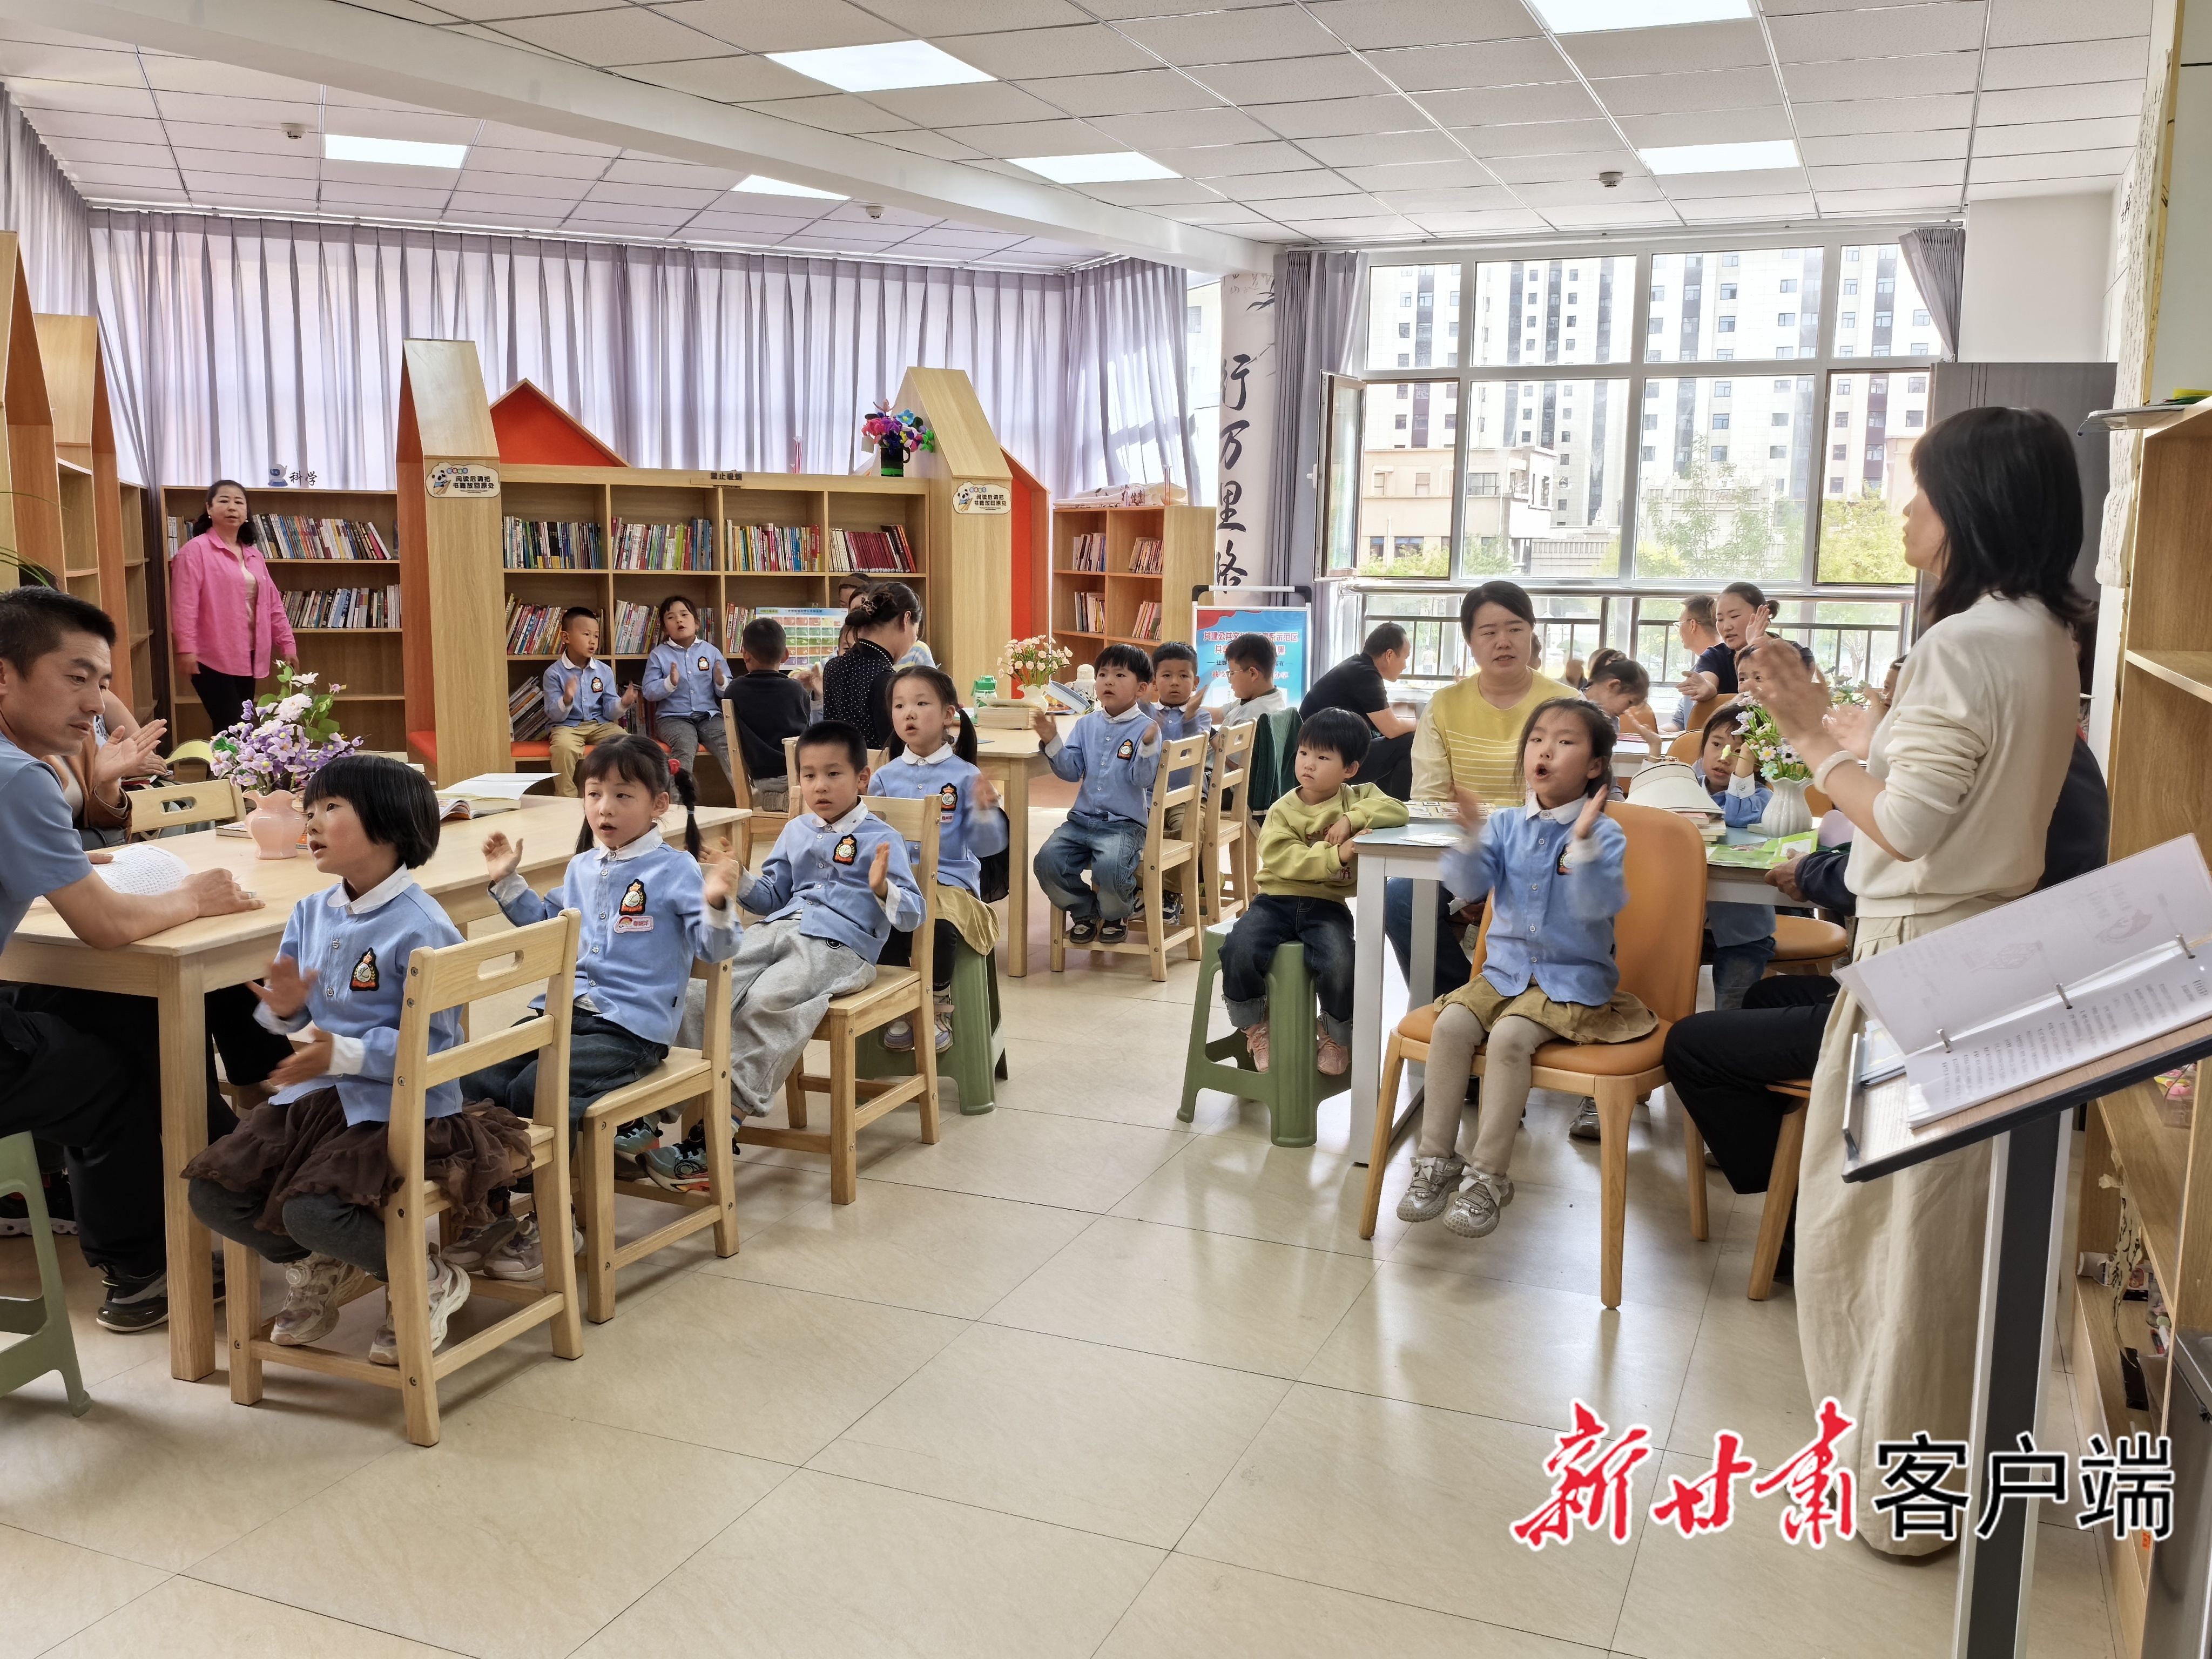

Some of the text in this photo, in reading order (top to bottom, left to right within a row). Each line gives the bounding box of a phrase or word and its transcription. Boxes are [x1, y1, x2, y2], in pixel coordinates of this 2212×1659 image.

[289, 470, 318, 486] 科学
[1204, 631, 1298, 642] 共建公共文系示范区
